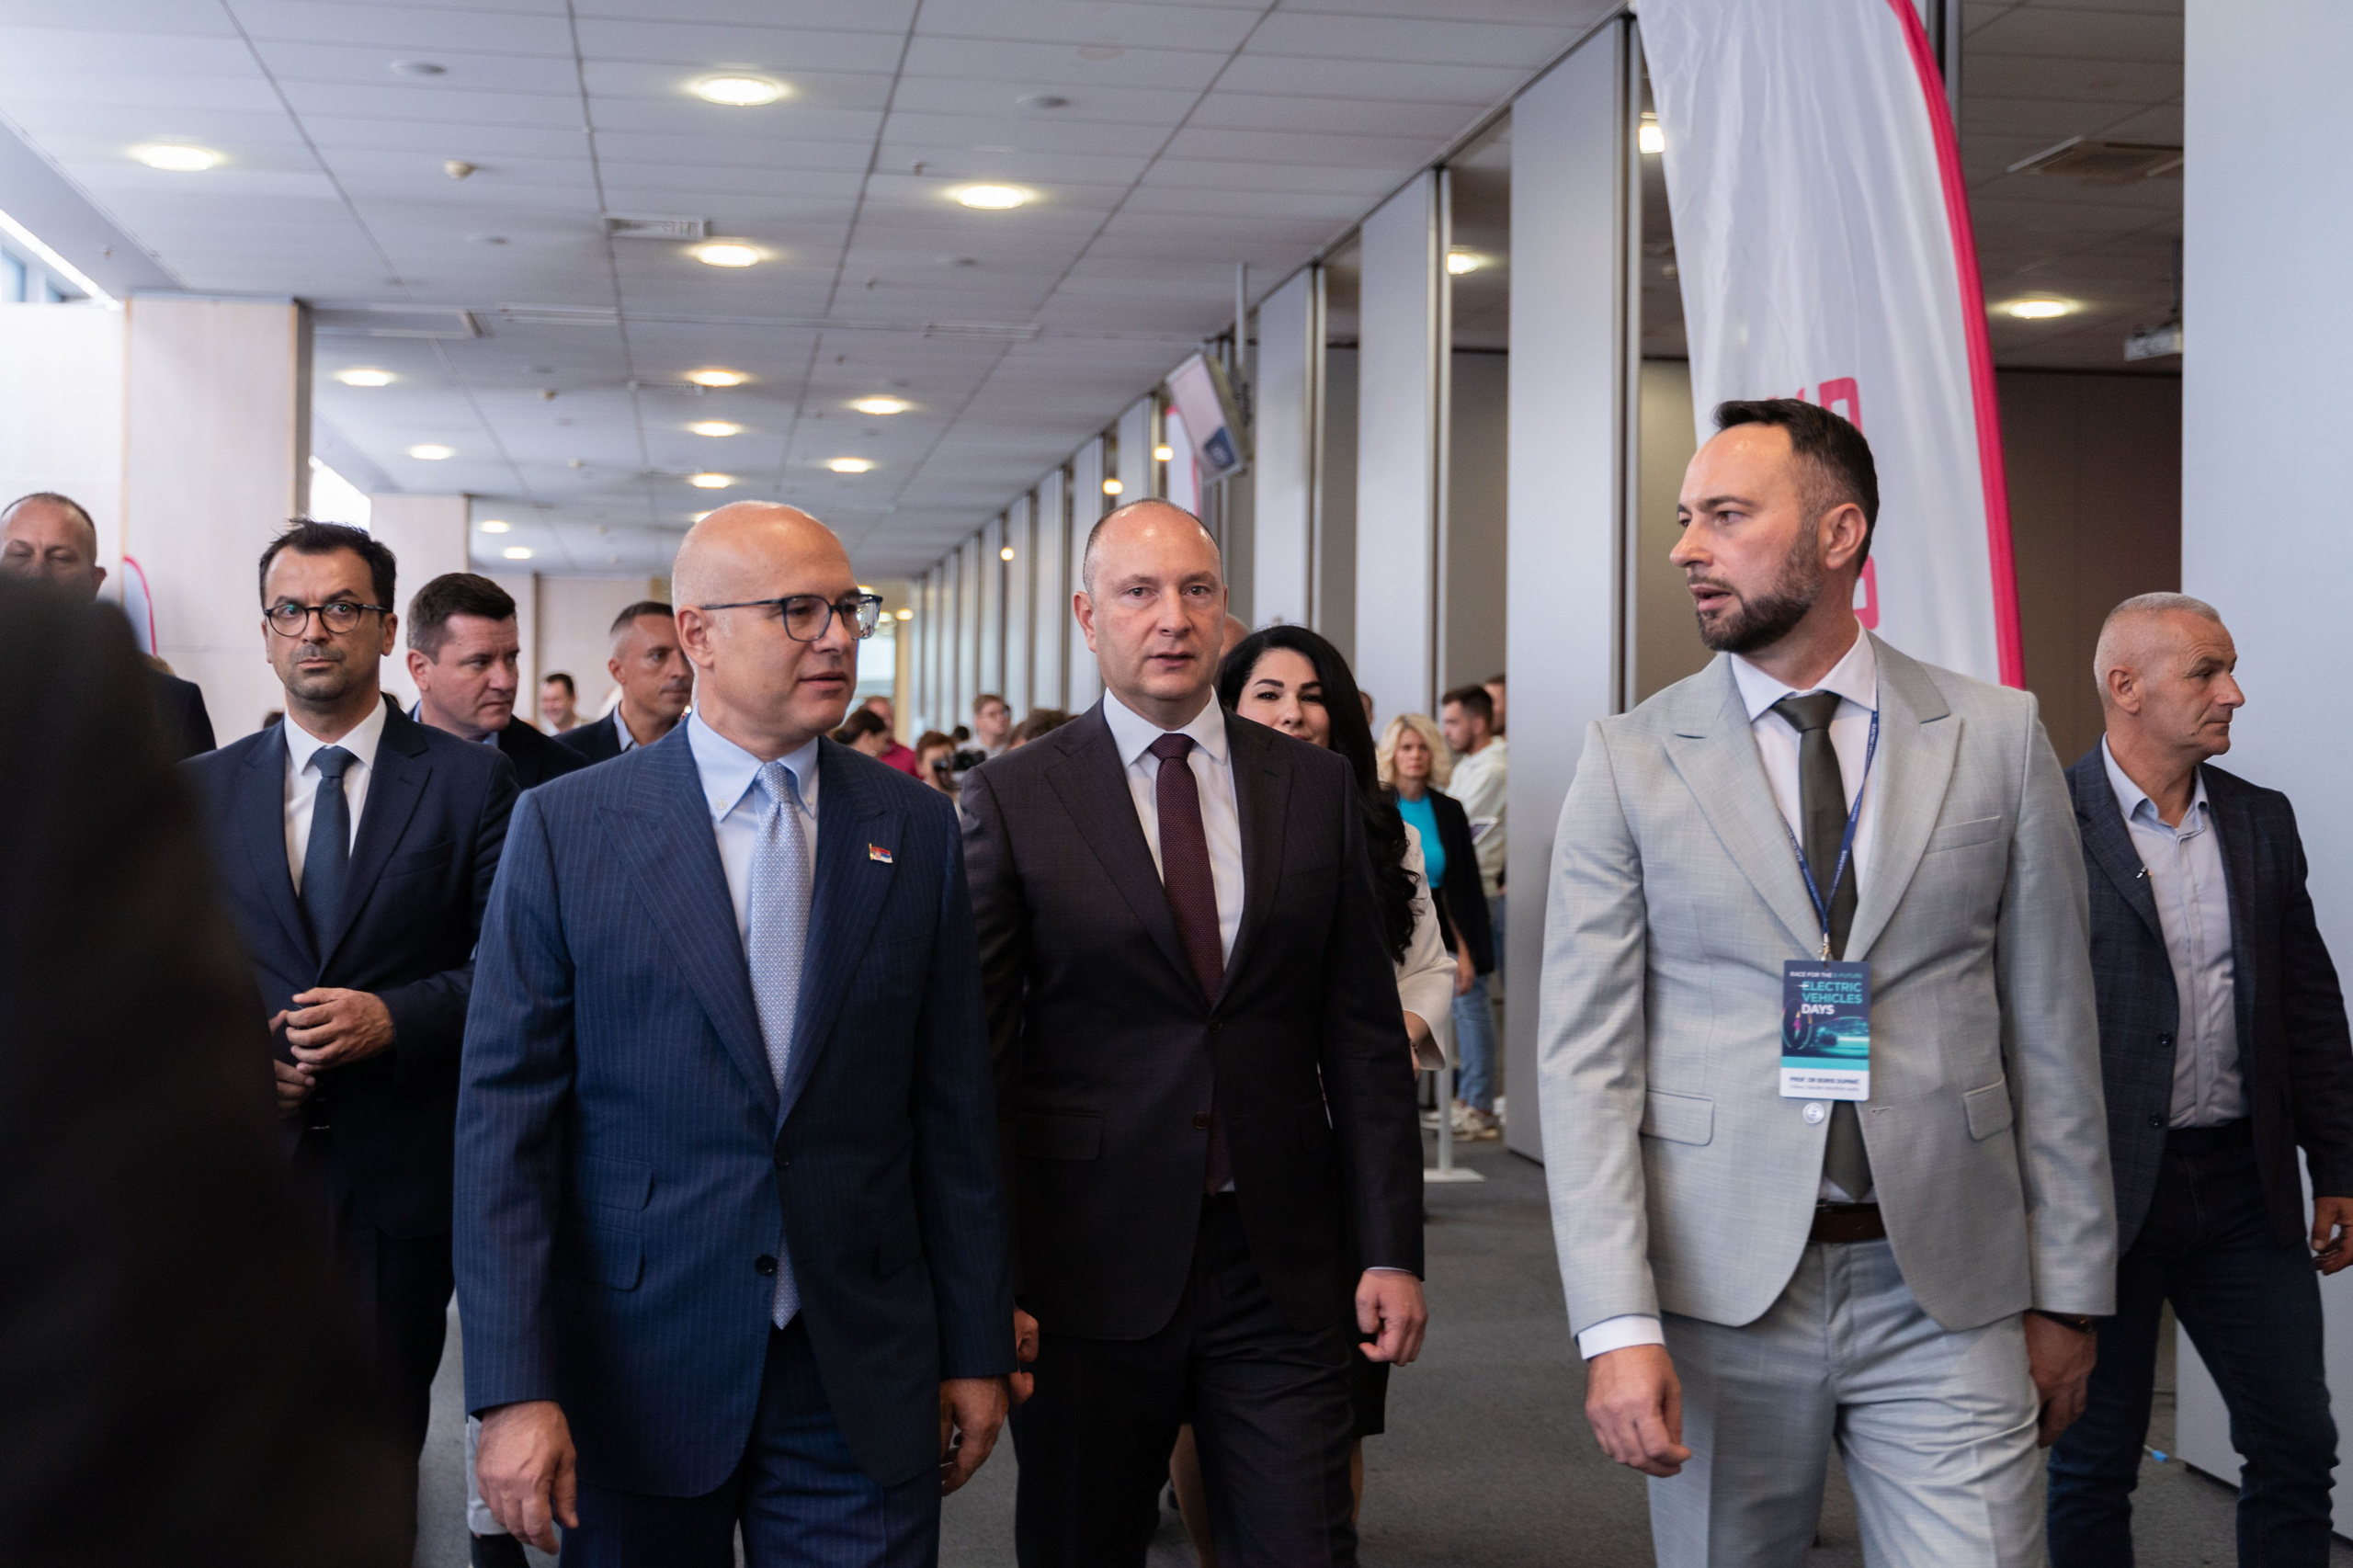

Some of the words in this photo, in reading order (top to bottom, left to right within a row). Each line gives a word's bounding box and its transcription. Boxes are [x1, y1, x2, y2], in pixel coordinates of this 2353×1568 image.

[1802, 981, 1862, 992] ELECTRIC
[1802, 993, 1863, 1004] VEHICLES
[1802, 1004, 1835, 1015] DAYS
